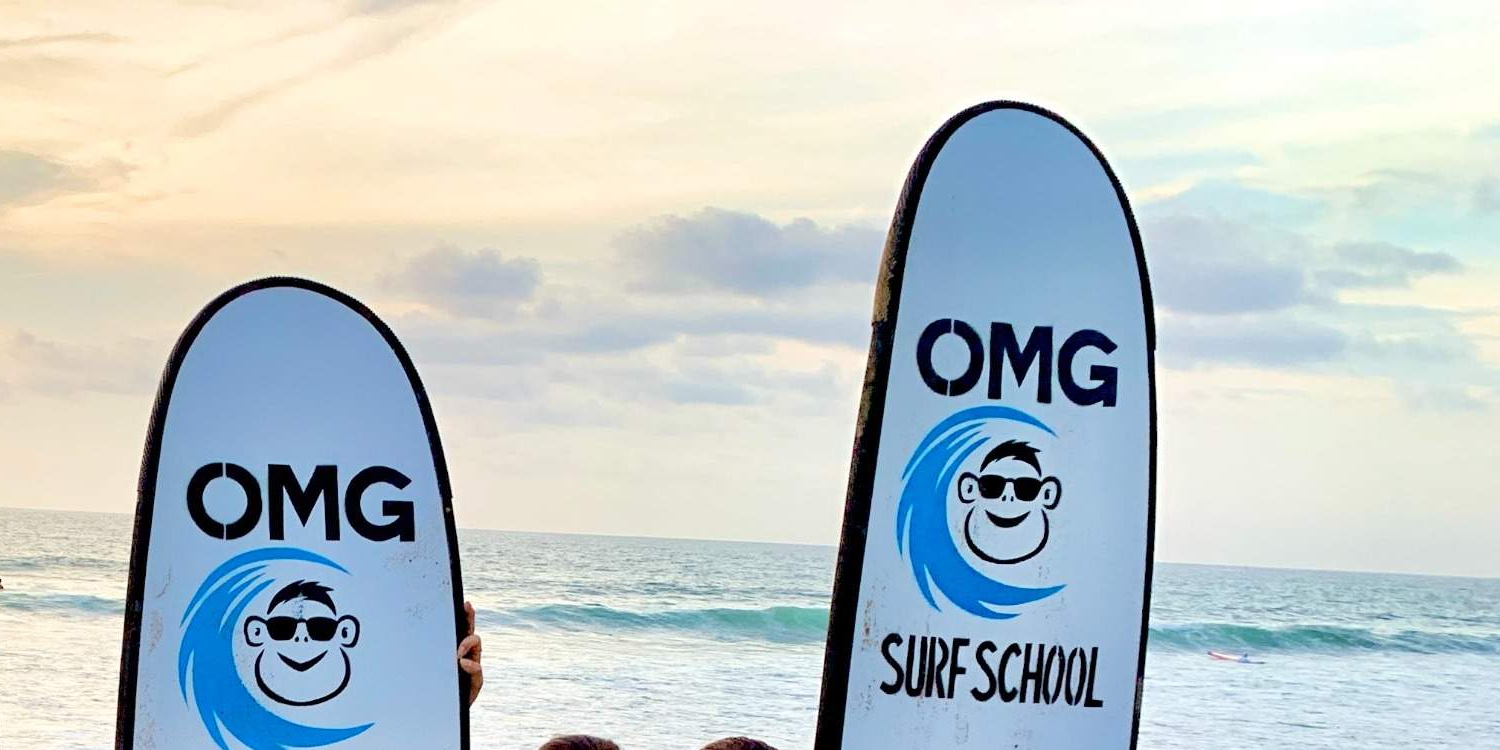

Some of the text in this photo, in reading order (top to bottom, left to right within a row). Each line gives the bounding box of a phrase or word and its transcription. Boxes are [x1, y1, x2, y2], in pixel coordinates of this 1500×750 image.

[916, 318, 1118, 408] OMG
[186, 462, 416, 543] OMG
[879, 632, 1104, 708] SURF SCHOOL
